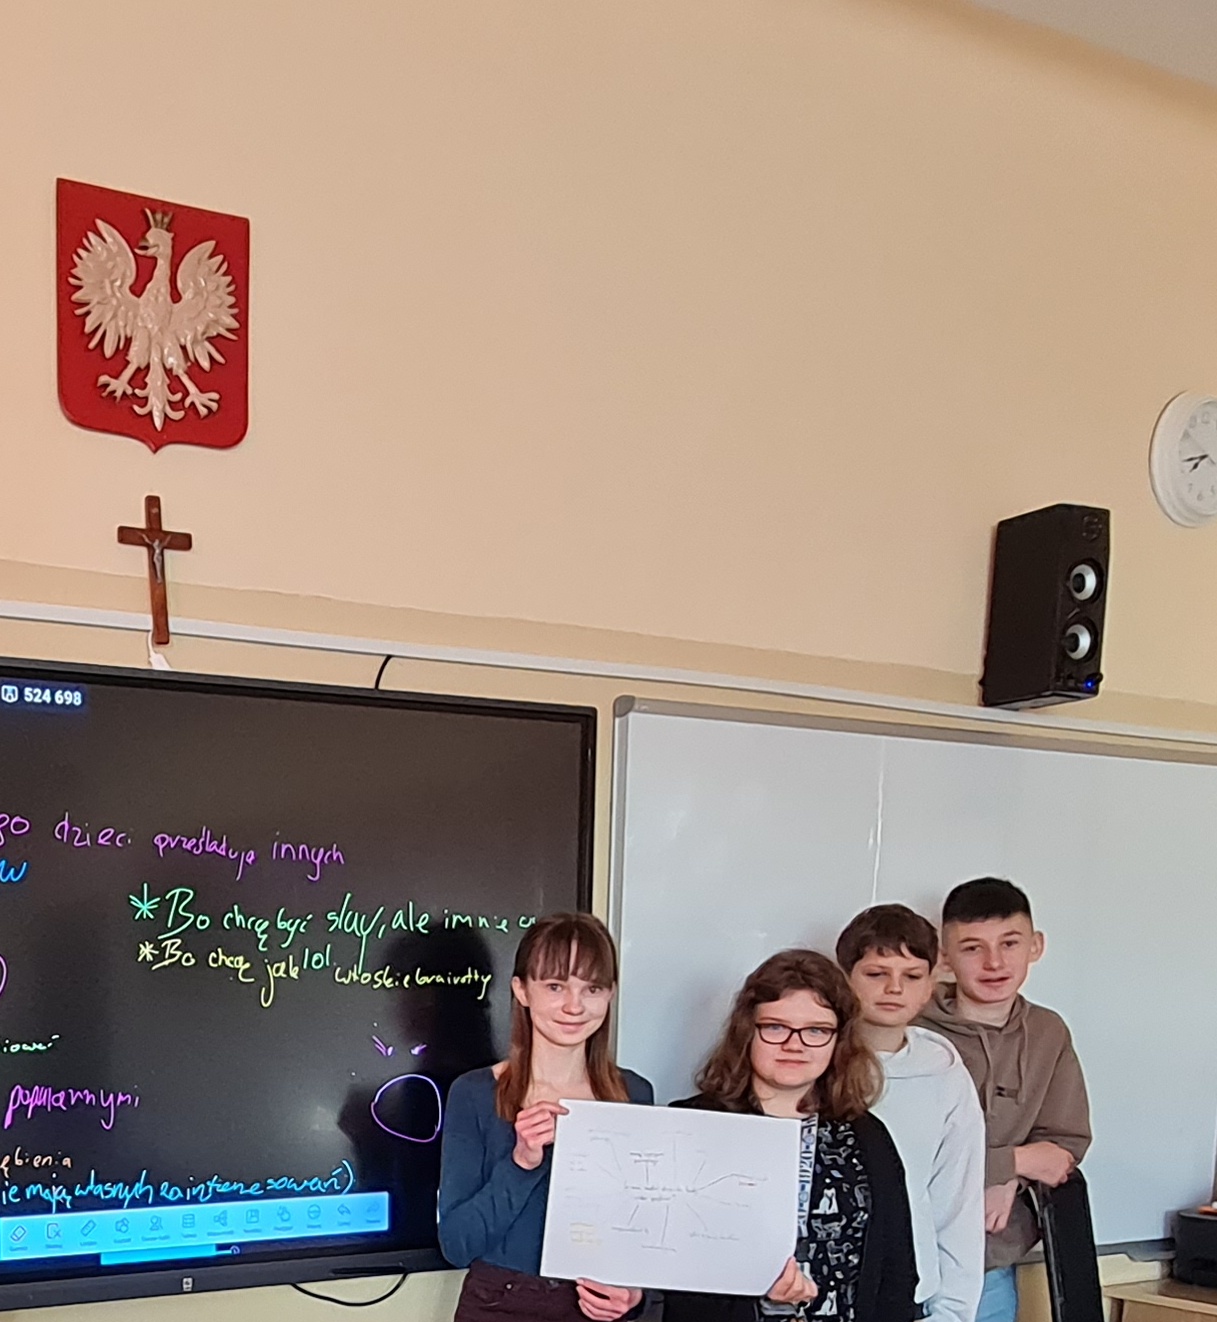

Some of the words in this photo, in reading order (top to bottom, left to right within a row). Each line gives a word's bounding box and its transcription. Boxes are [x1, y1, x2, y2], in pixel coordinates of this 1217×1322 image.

[24, 687, 51, 704] 524
[55, 689, 82, 706] 698
[272, 831, 344, 881] innych
[157, 888, 210, 940] Bo
[392, 901, 429, 934] ale
[151, 938, 196, 970] Bo
